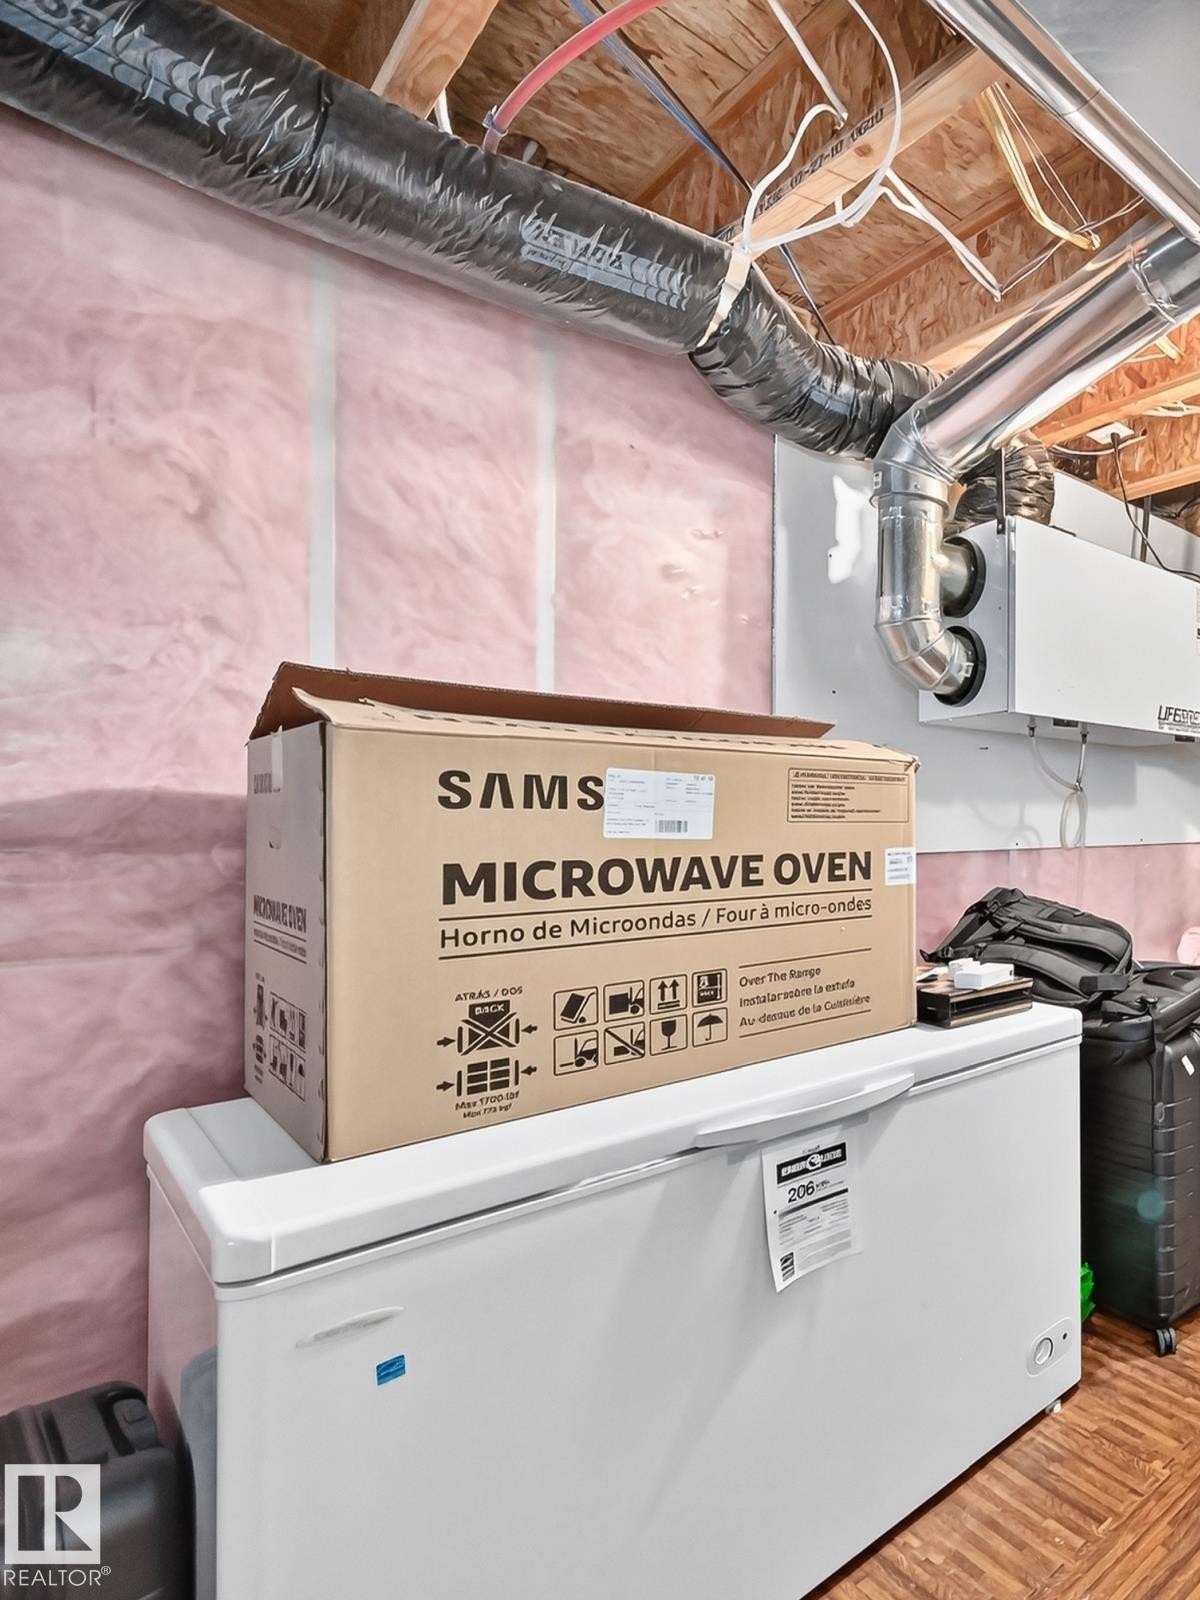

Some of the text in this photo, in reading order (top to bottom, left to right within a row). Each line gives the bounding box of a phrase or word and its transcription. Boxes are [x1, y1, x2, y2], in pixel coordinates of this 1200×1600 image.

[438, 770, 604, 811] SAMS
[442, 855, 764, 905] MICROWAVE
[773, 851, 872, 886] OVEN
[441, 897, 872, 949] Horno de Microondas / Four à micro-ondes
[739, 976, 766, 988] Over
[767, 972, 787, 983] The
[501, 986, 523, 997] DOS
[475, 1003, 505, 1016] BACK
[798, 1006, 811, 1016] de
[813, 1003, 822, 1014] la
[787, 1180, 815, 1203] 206
